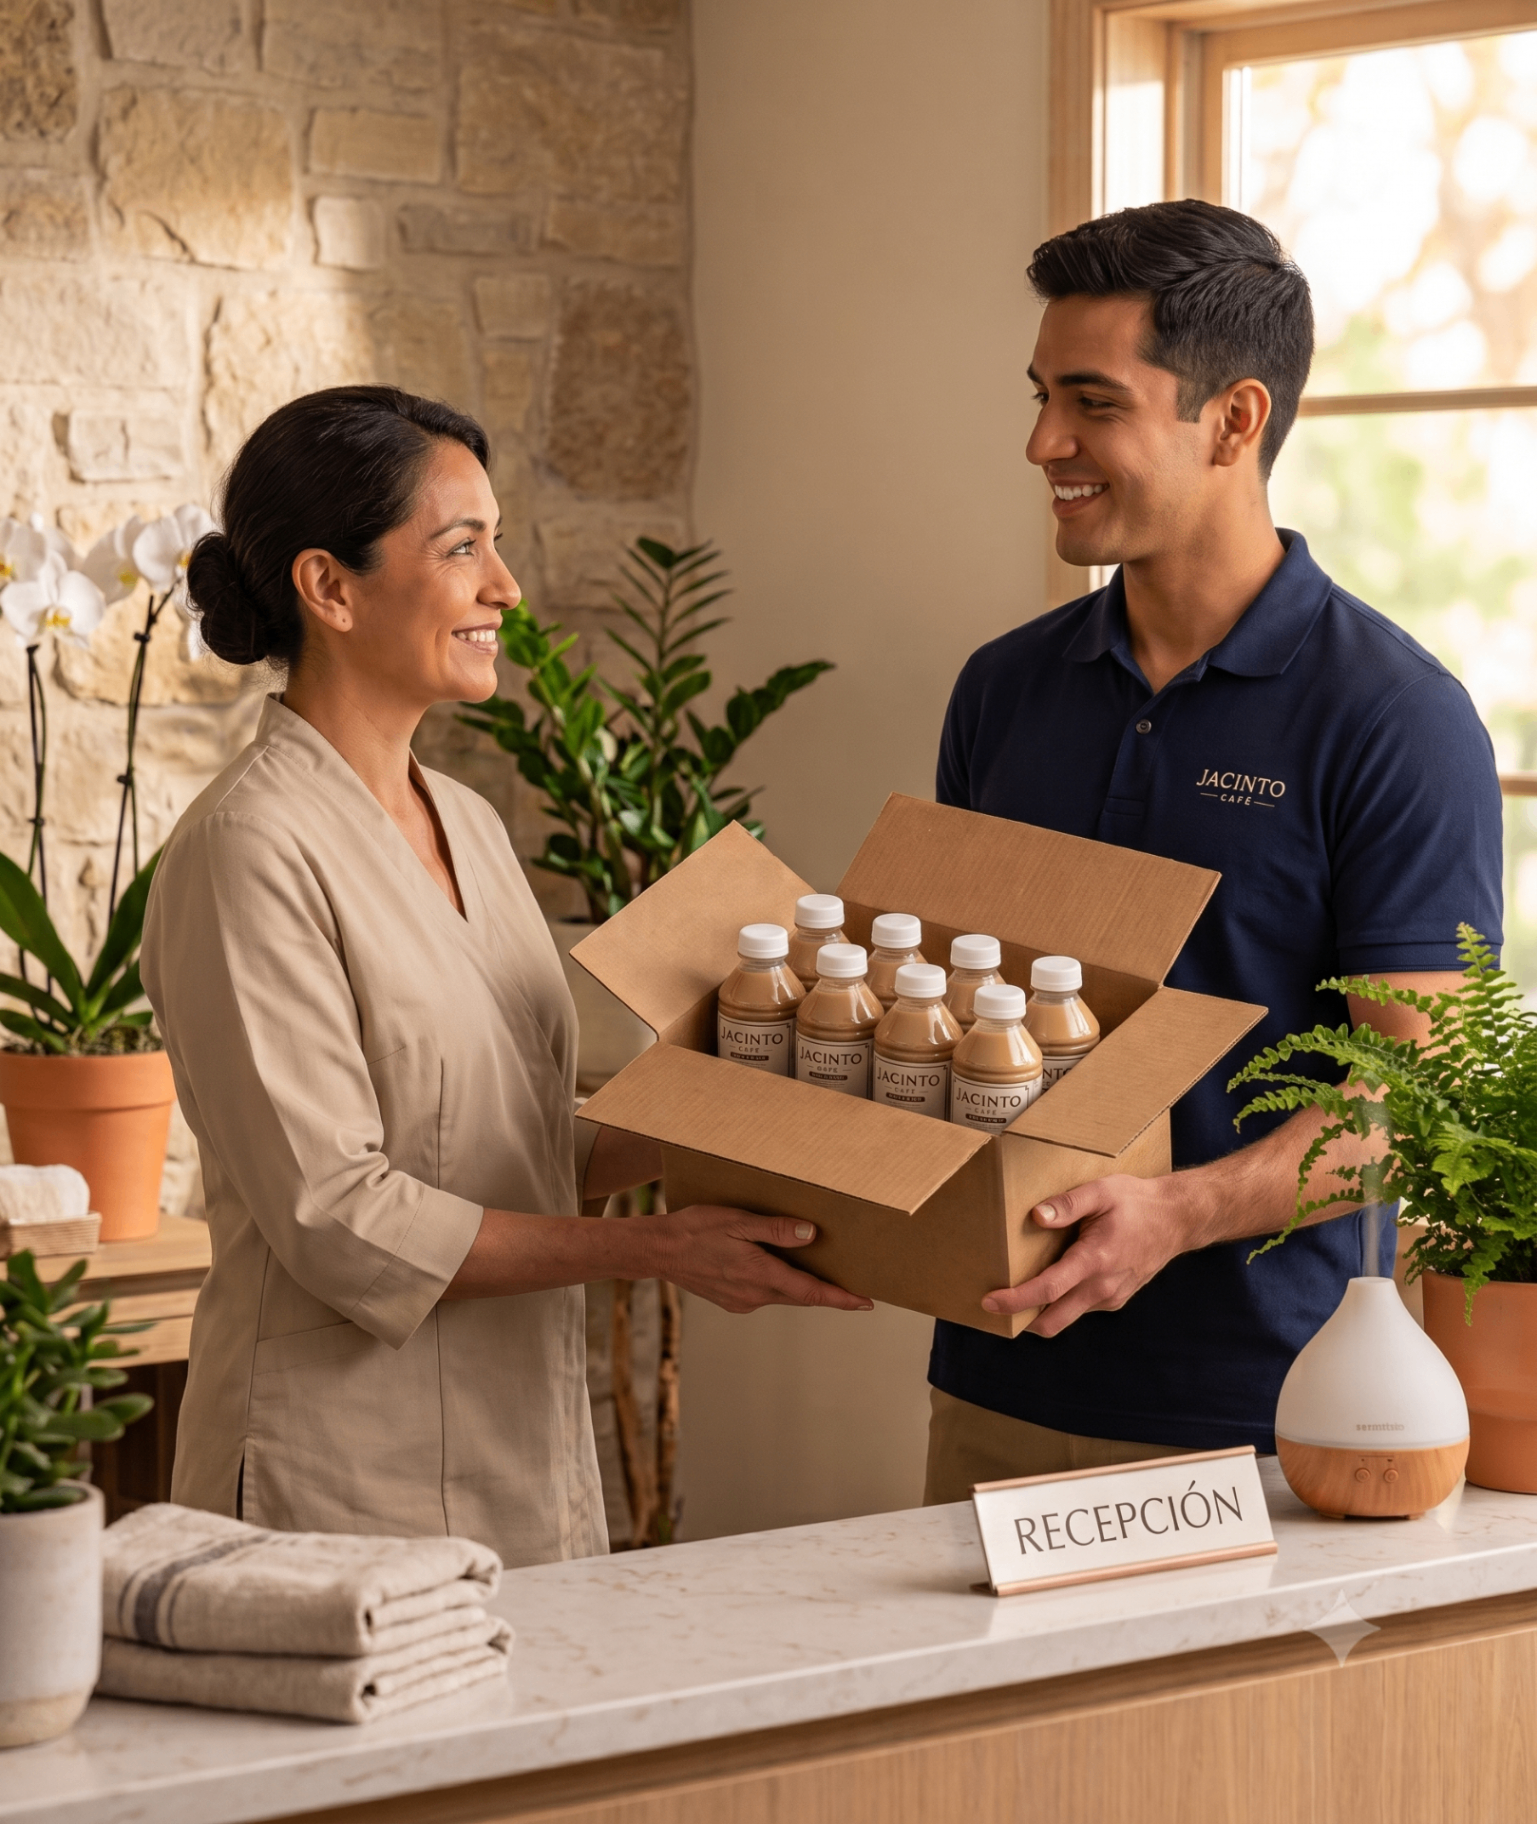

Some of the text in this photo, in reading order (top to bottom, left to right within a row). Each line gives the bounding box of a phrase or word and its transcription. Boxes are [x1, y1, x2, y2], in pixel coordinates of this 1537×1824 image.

[1196, 769, 1286, 798] JACINTO
[721, 1026, 784, 1046] JACINTO
[800, 1046, 862, 1066] JACINTO
[877, 1067, 940, 1087] JACINTO
[956, 1087, 1021, 1109] JACINTO
[1014, 1480, 1243, 1554] RECEPCIÓN
